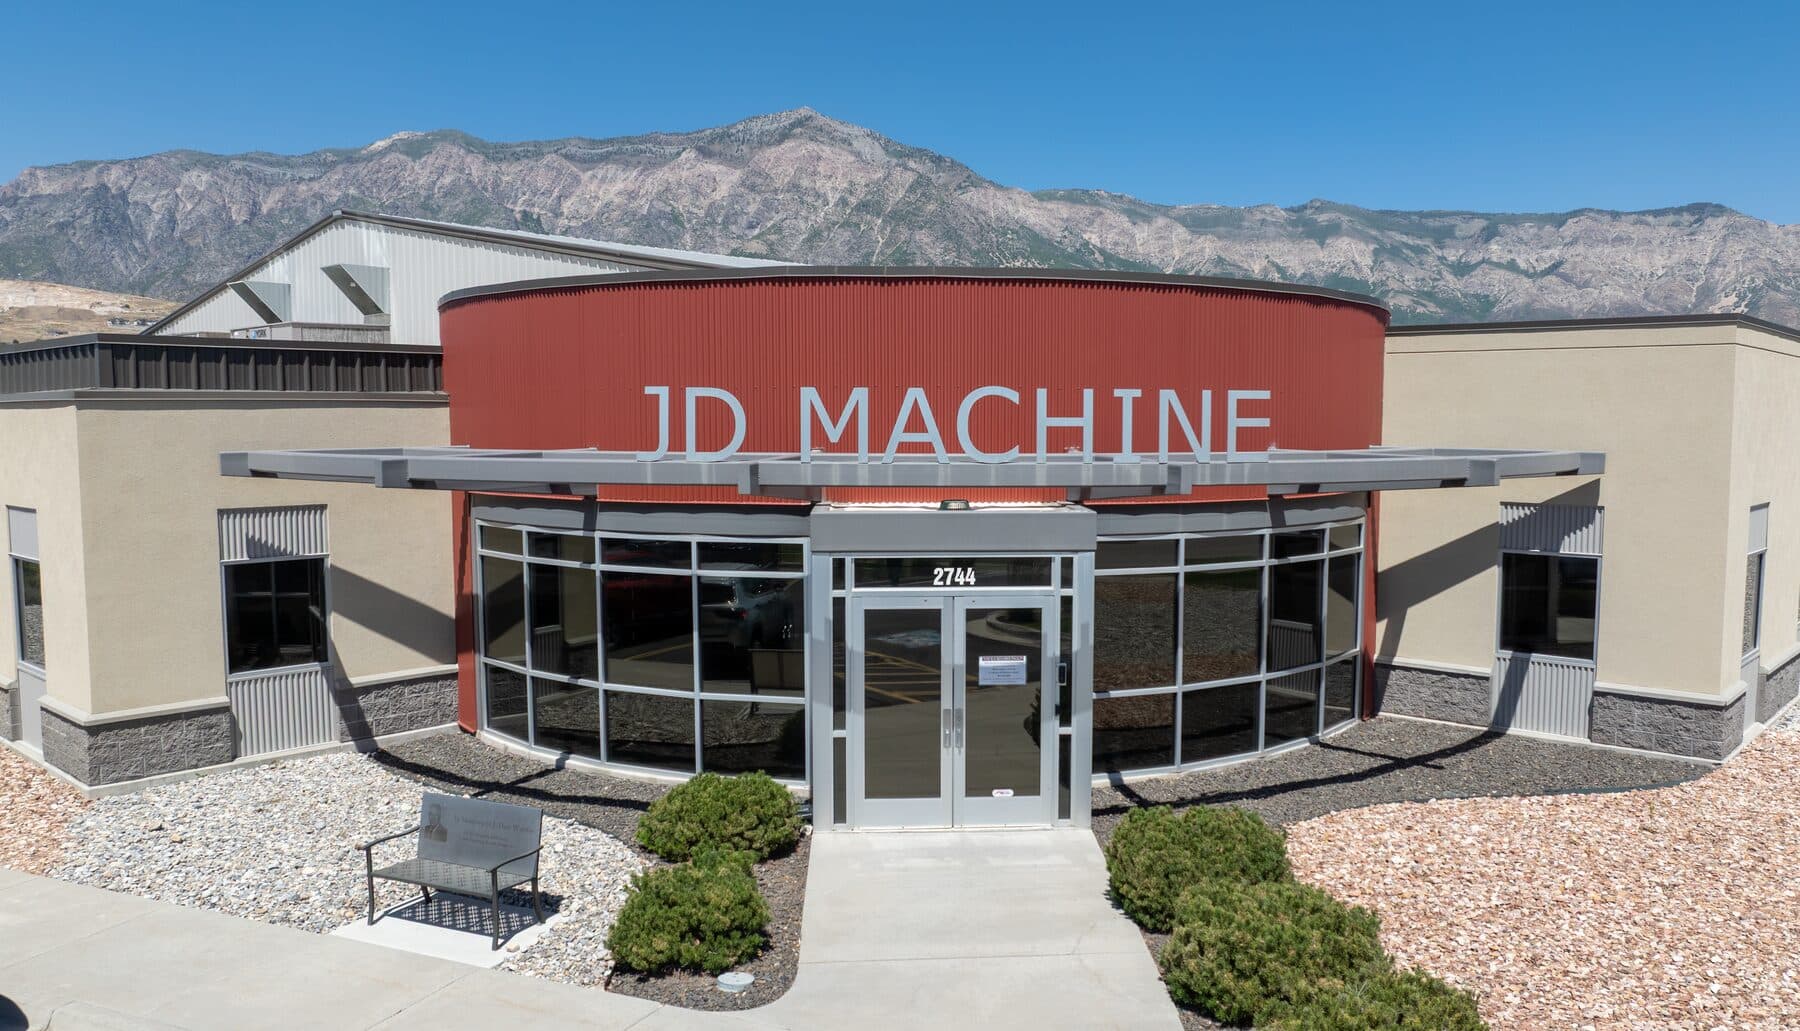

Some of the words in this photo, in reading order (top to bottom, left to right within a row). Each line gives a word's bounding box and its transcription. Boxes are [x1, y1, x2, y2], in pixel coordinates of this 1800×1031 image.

[636, 386, 746, 462] JD
[800, 386, 1271, 464] MACHINE
[933, 567, 976, 585] 2744
